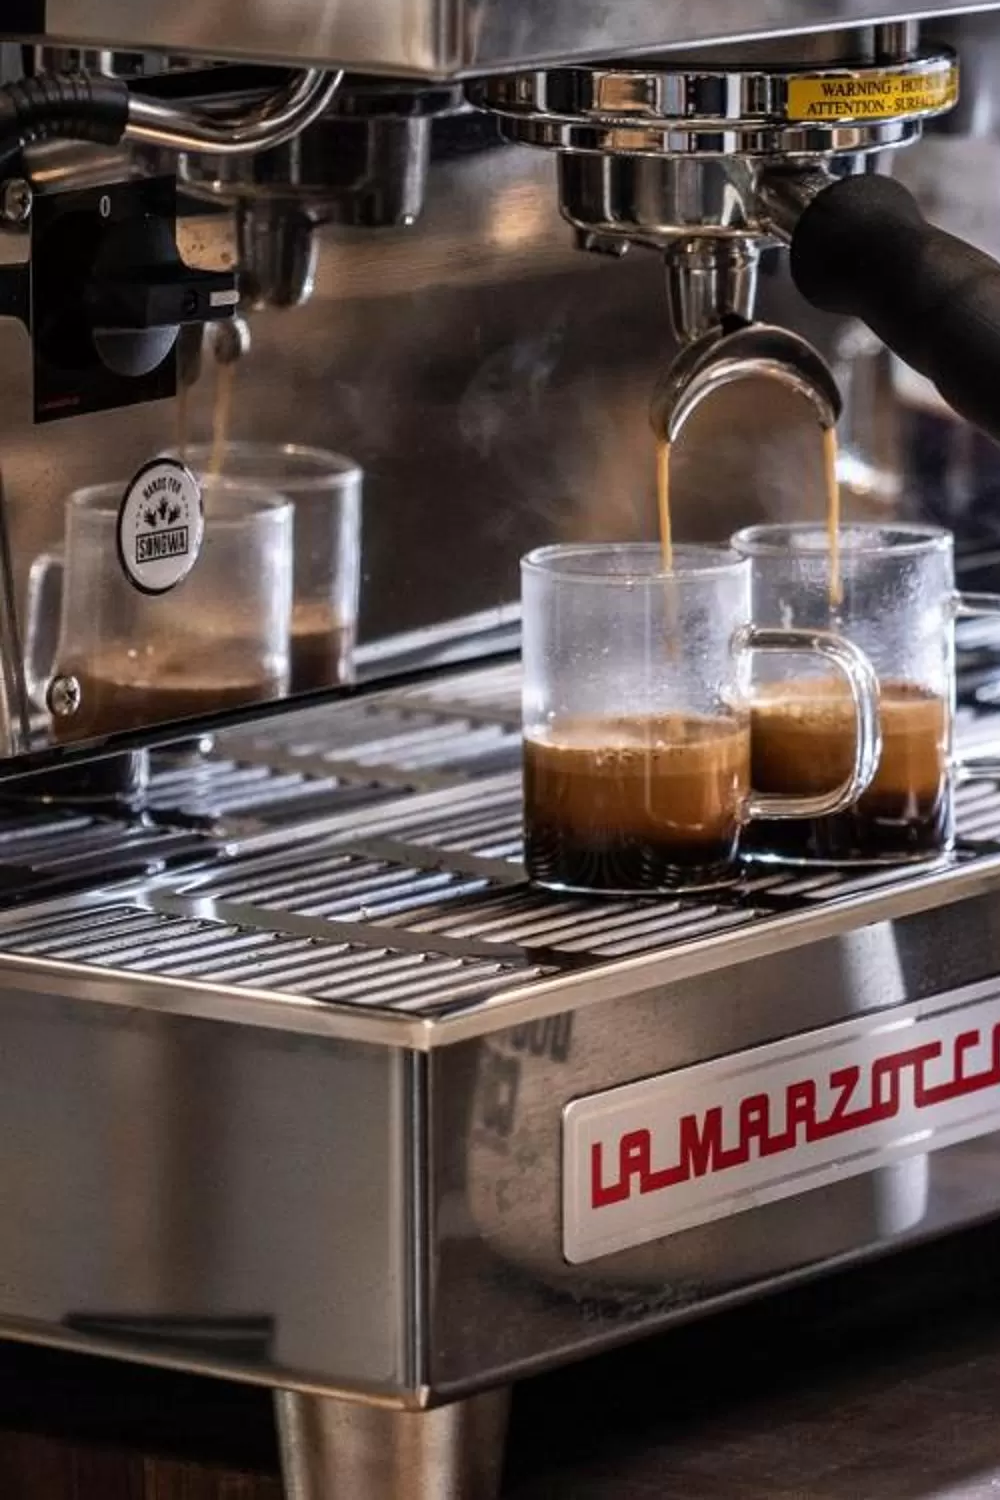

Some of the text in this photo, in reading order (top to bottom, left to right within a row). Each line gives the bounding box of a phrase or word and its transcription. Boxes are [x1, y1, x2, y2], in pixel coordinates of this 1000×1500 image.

[821, 81, 891, 97] WARNING
[807, 100, 884, 116] ATTENTION
[139, 531, 185, 558] SONGWA
[590, 1128, 652, 1208] LA
